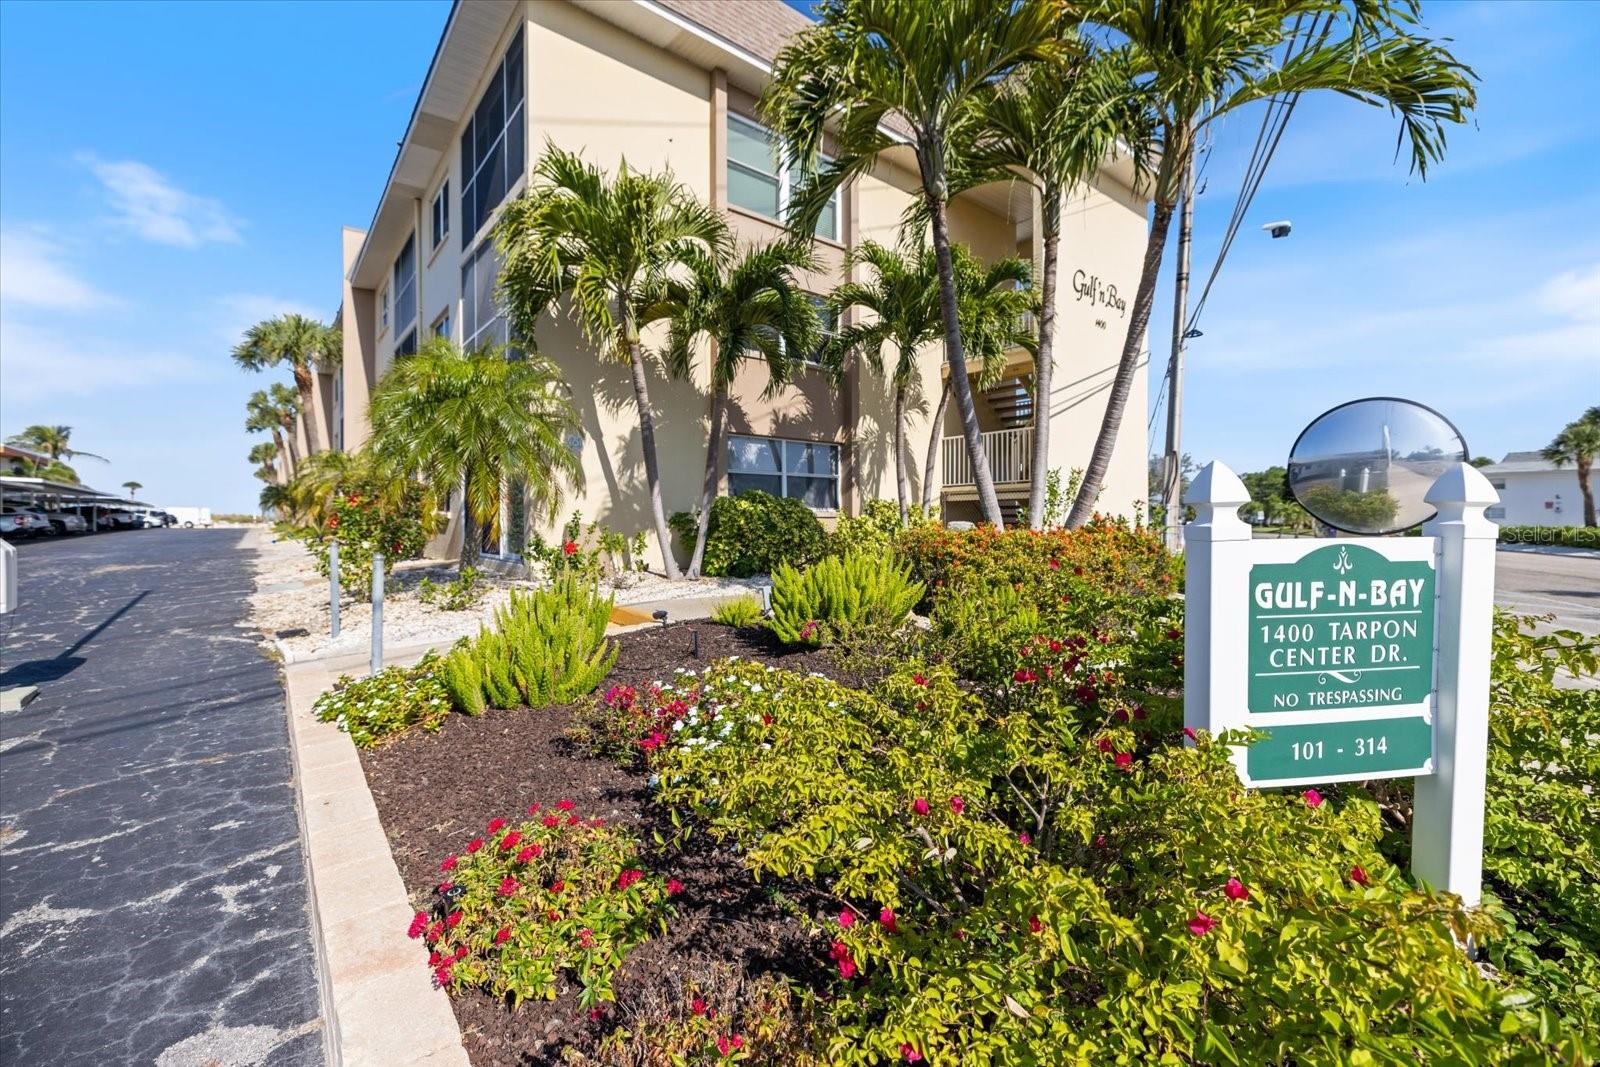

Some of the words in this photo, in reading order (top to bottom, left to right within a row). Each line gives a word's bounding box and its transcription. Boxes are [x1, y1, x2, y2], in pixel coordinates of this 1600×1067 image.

[1073, 269, 1098, 306] Gulf
[1105, 284, 1126, 318] Bay
[1254, 578, 1425, 611] GULF-N-BAY
[1260, 623, 1314, 644] 1400
[1328, 619, 1418, 641] TARPON
[1269, 646, 1356, 668] CENTER
[1371, 643, 1408, 663] DR.
[1273, 692, 1299, 708] NO
[1308, 687, 1403, 706] TRESPASSING
[1291, 741, 1323, 761] 101
[1354, 736, 1388, 757] 314
